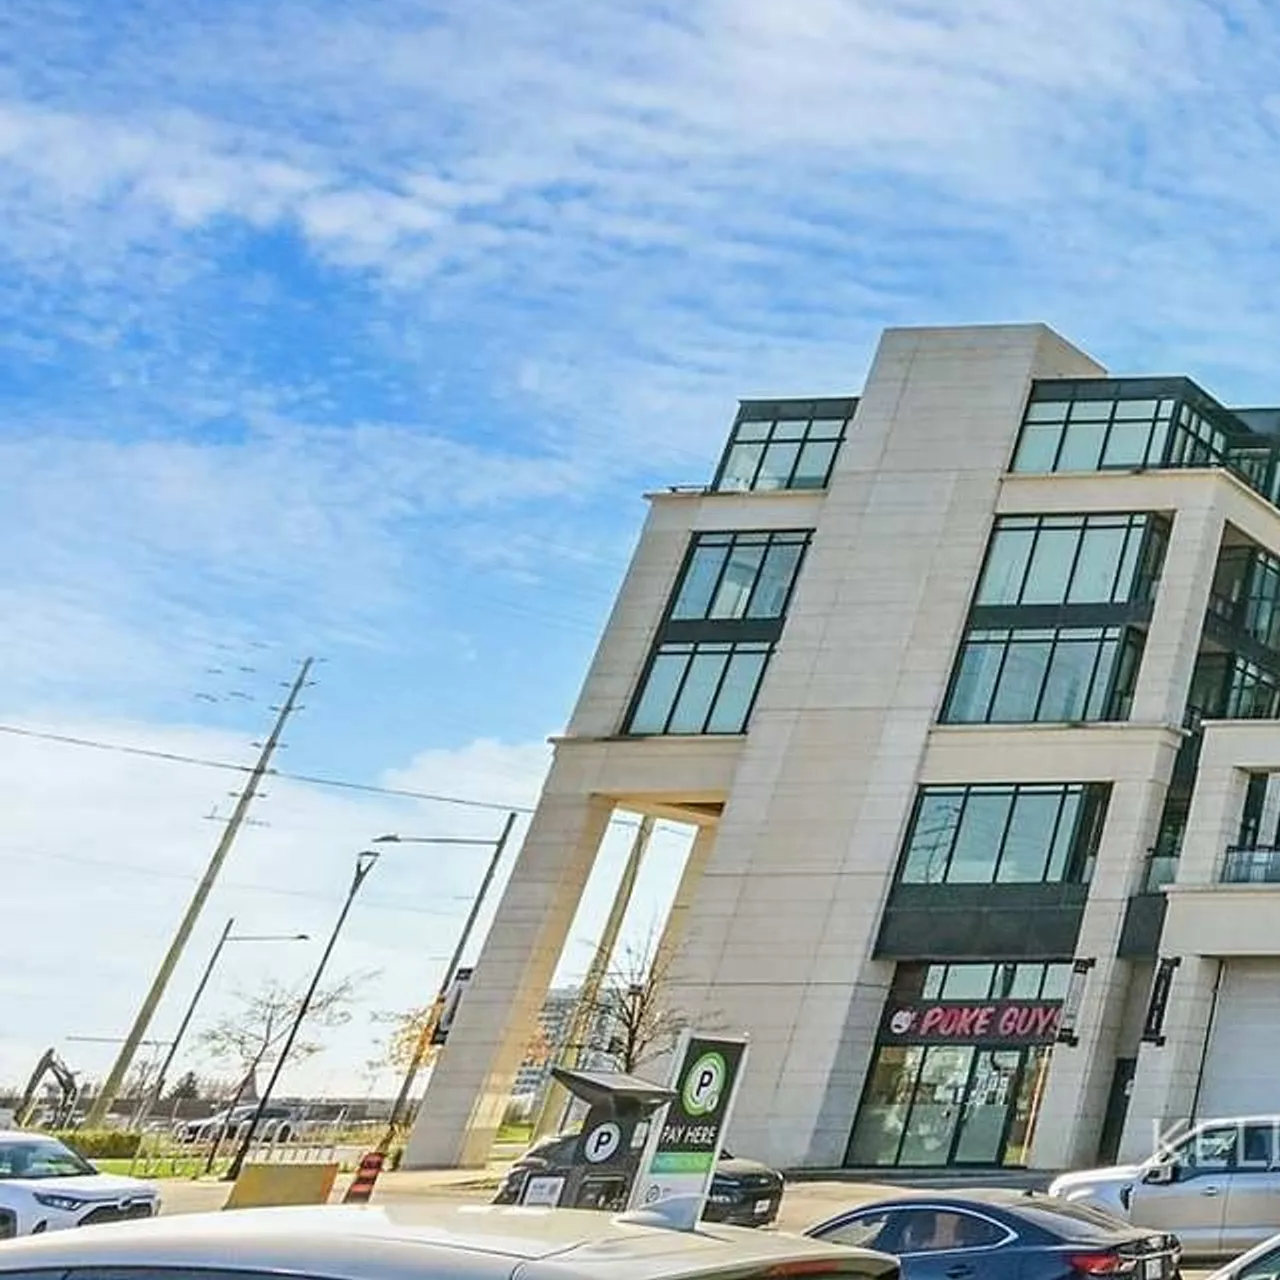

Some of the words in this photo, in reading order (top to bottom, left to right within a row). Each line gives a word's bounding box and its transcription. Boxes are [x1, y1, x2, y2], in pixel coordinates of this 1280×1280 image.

[919, 1006, 993, 1036] POKE
[696, 1070, 713, 1097] P
[594, 1131, 611, 1153] P
[661, 1124, 686, 1144] PAY
[684, 1124, 718, 1145] HERE
